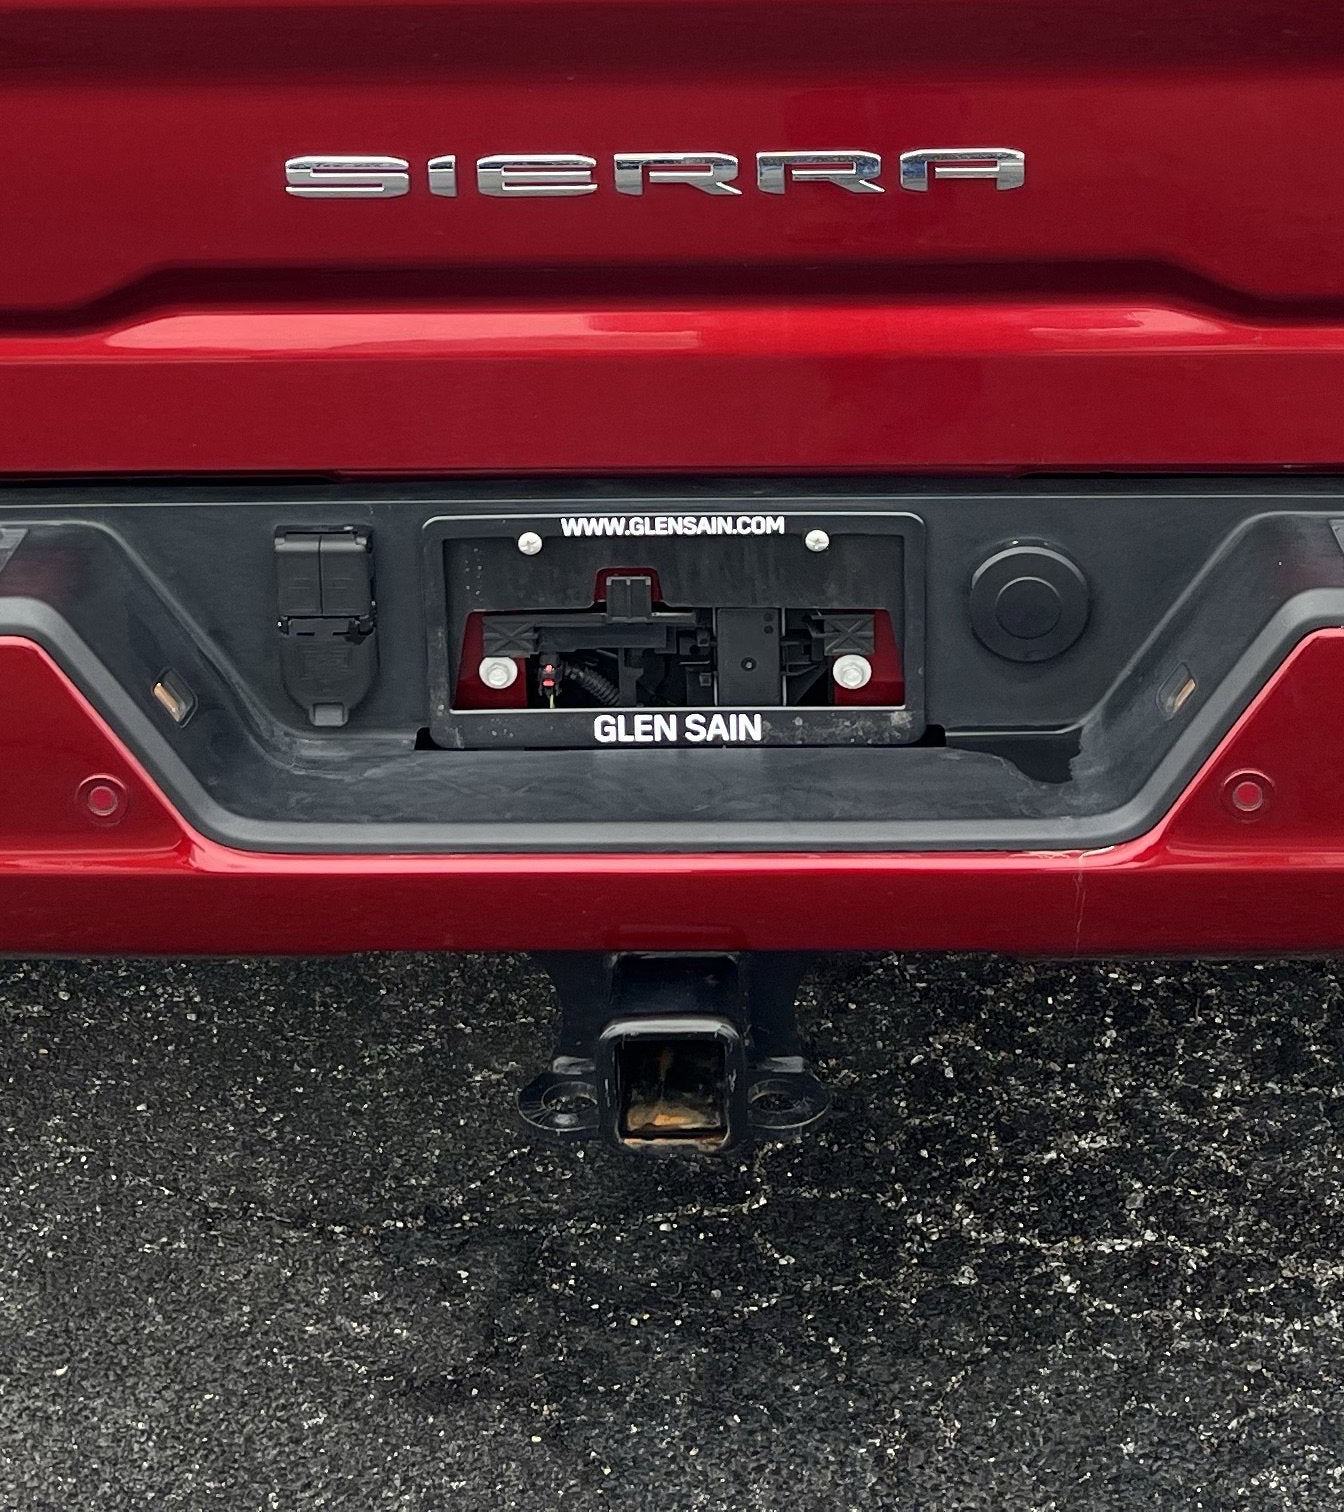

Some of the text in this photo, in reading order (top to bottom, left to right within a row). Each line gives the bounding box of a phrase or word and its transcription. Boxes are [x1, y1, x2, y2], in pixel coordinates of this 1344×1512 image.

[285, 148, 1026, 197] SIERRA
[560, 515, 785, 537] WWW.GLENSAIN.COM
[593, 713, 762, 743] GLEN SAIN
